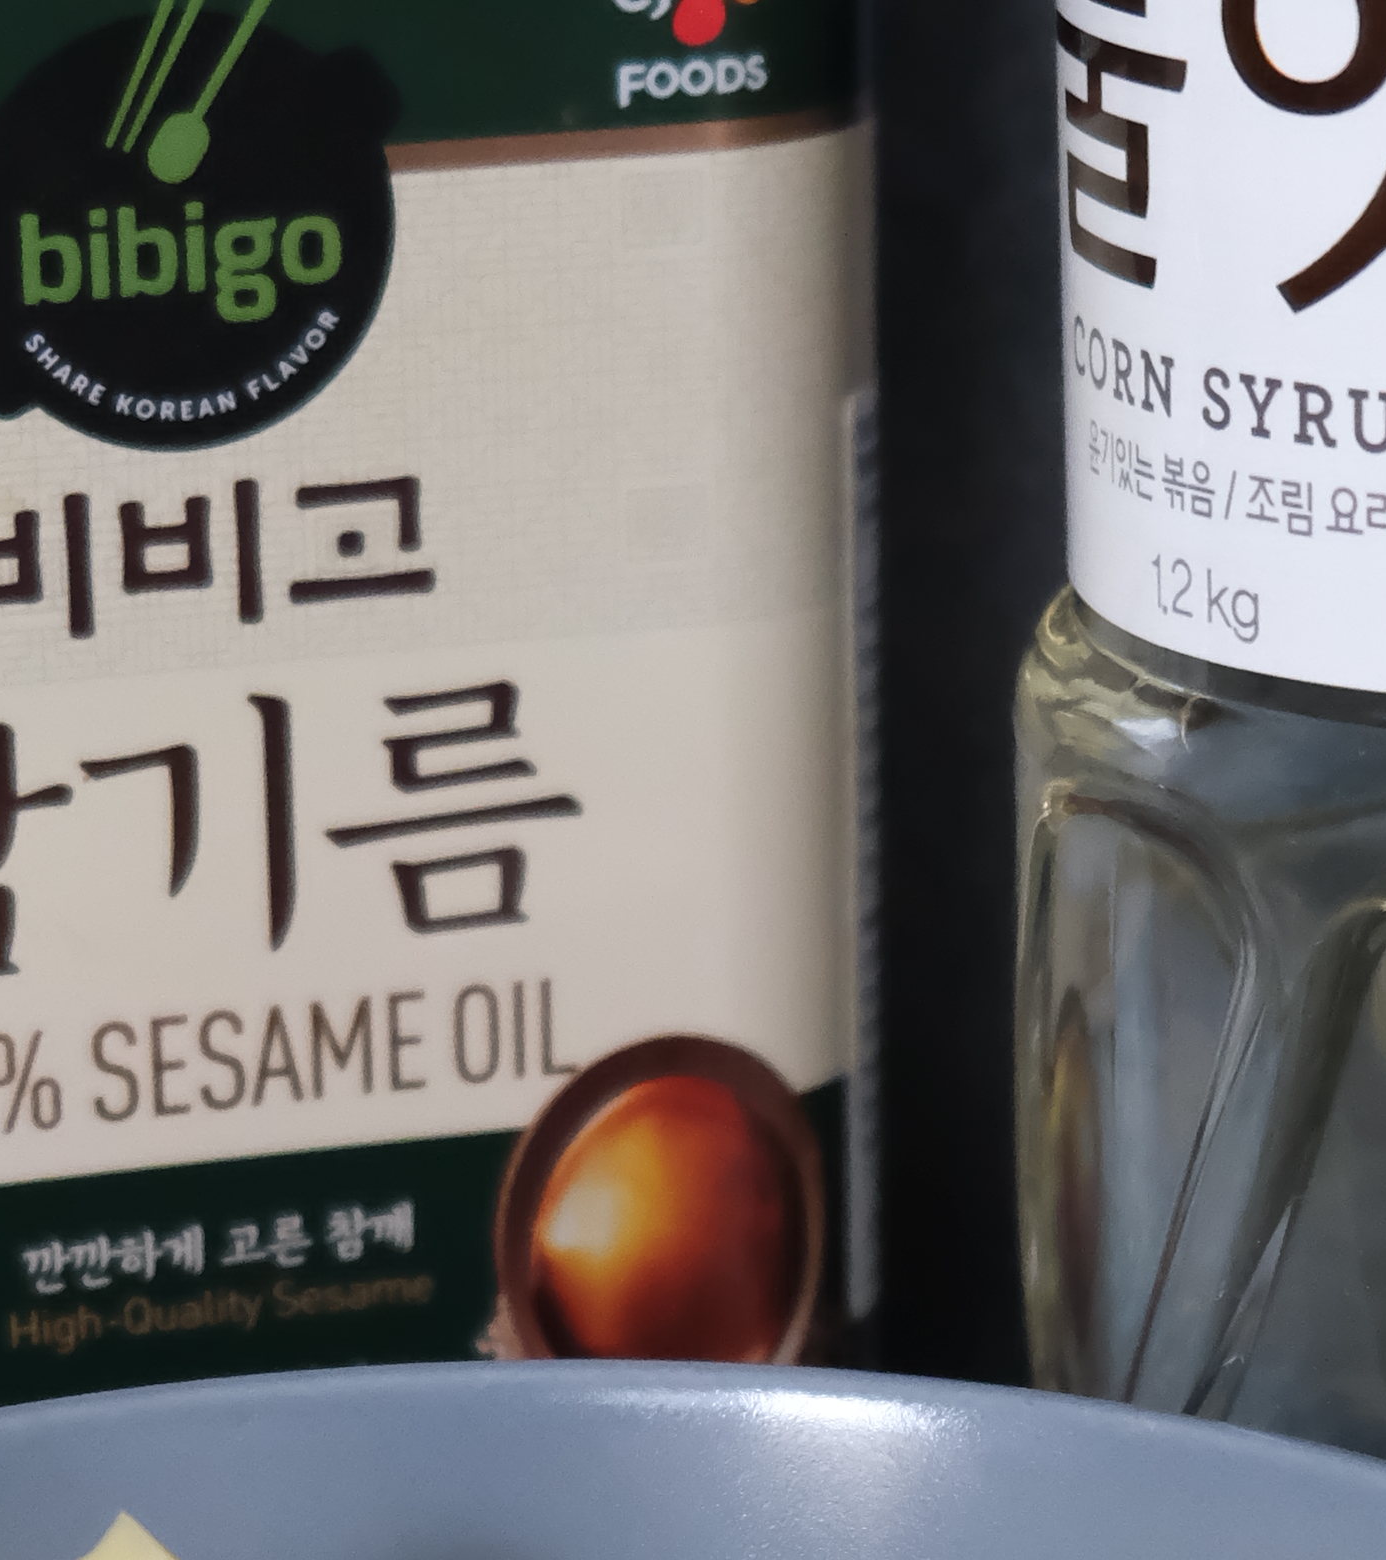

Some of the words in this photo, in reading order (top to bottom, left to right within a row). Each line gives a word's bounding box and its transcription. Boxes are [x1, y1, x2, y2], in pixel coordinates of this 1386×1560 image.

[617, 53, 769, 111] FOODS
[20, 200, 343, 324] bibigo
[23, 332, 106, 407] SHARE
[114, 389, 239, 422] KOREAN
[244, 308, 341, 401] FLAVOR
[1073, 314, 1175, 419] CORN
[1162, 452, 1216, 520] 볶음
[1245, 473, 1313, 538] 조림
[91, 987, 428, 1124] SESAME
[451, 977, 579, 1086] OIL
[21, 1223, 207, 1297] 깐깐하게
[220, 1209, 313, 1270] 고른
[326, 1198, 415, 1263] 참깨
[271, 1273, 434, 1320] Sesame
